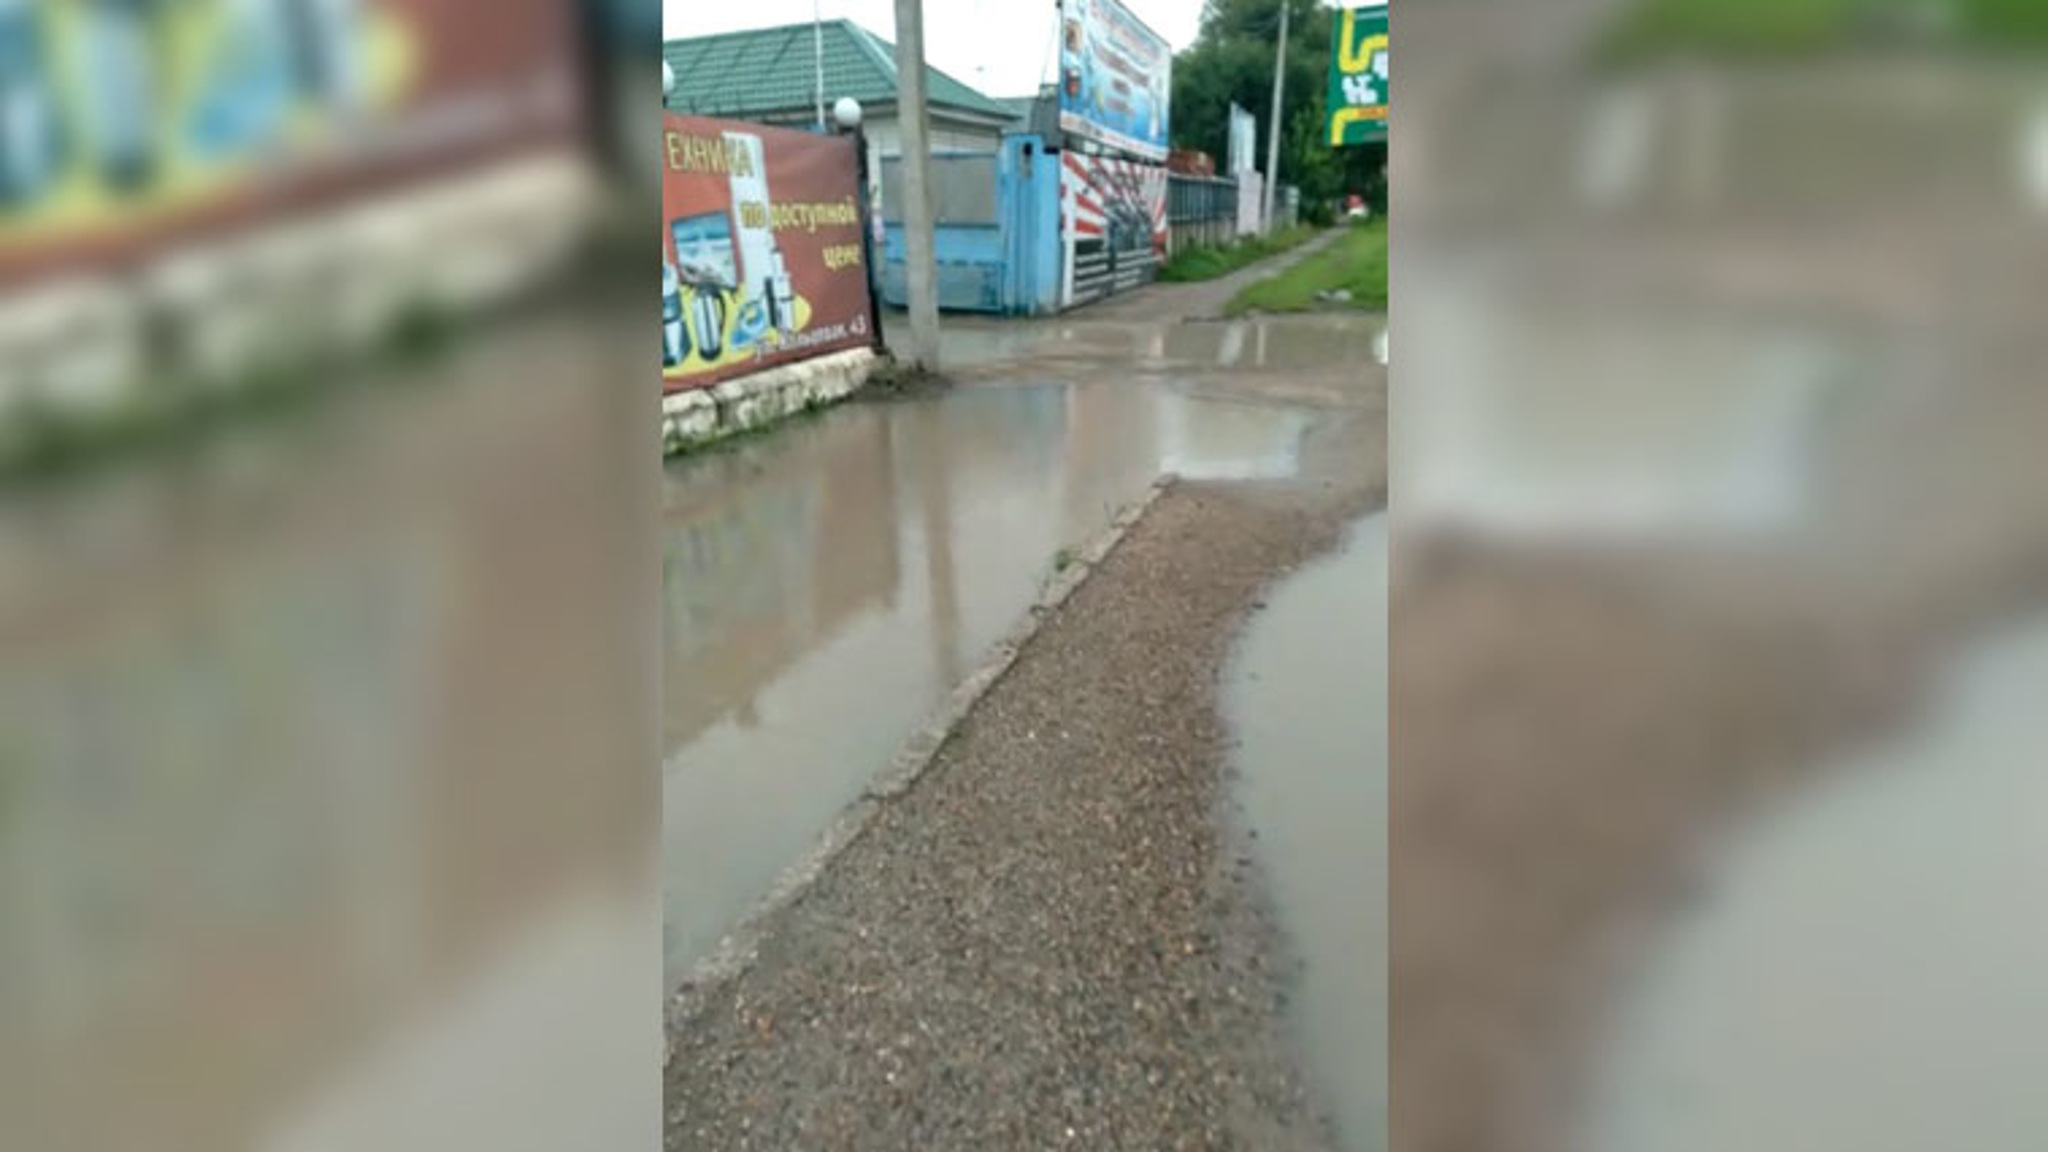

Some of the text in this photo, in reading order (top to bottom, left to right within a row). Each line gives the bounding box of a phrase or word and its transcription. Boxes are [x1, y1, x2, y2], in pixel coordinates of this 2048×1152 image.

[740, 195, 858, 234] по доступной
[821, 242, 860, 270] цене
